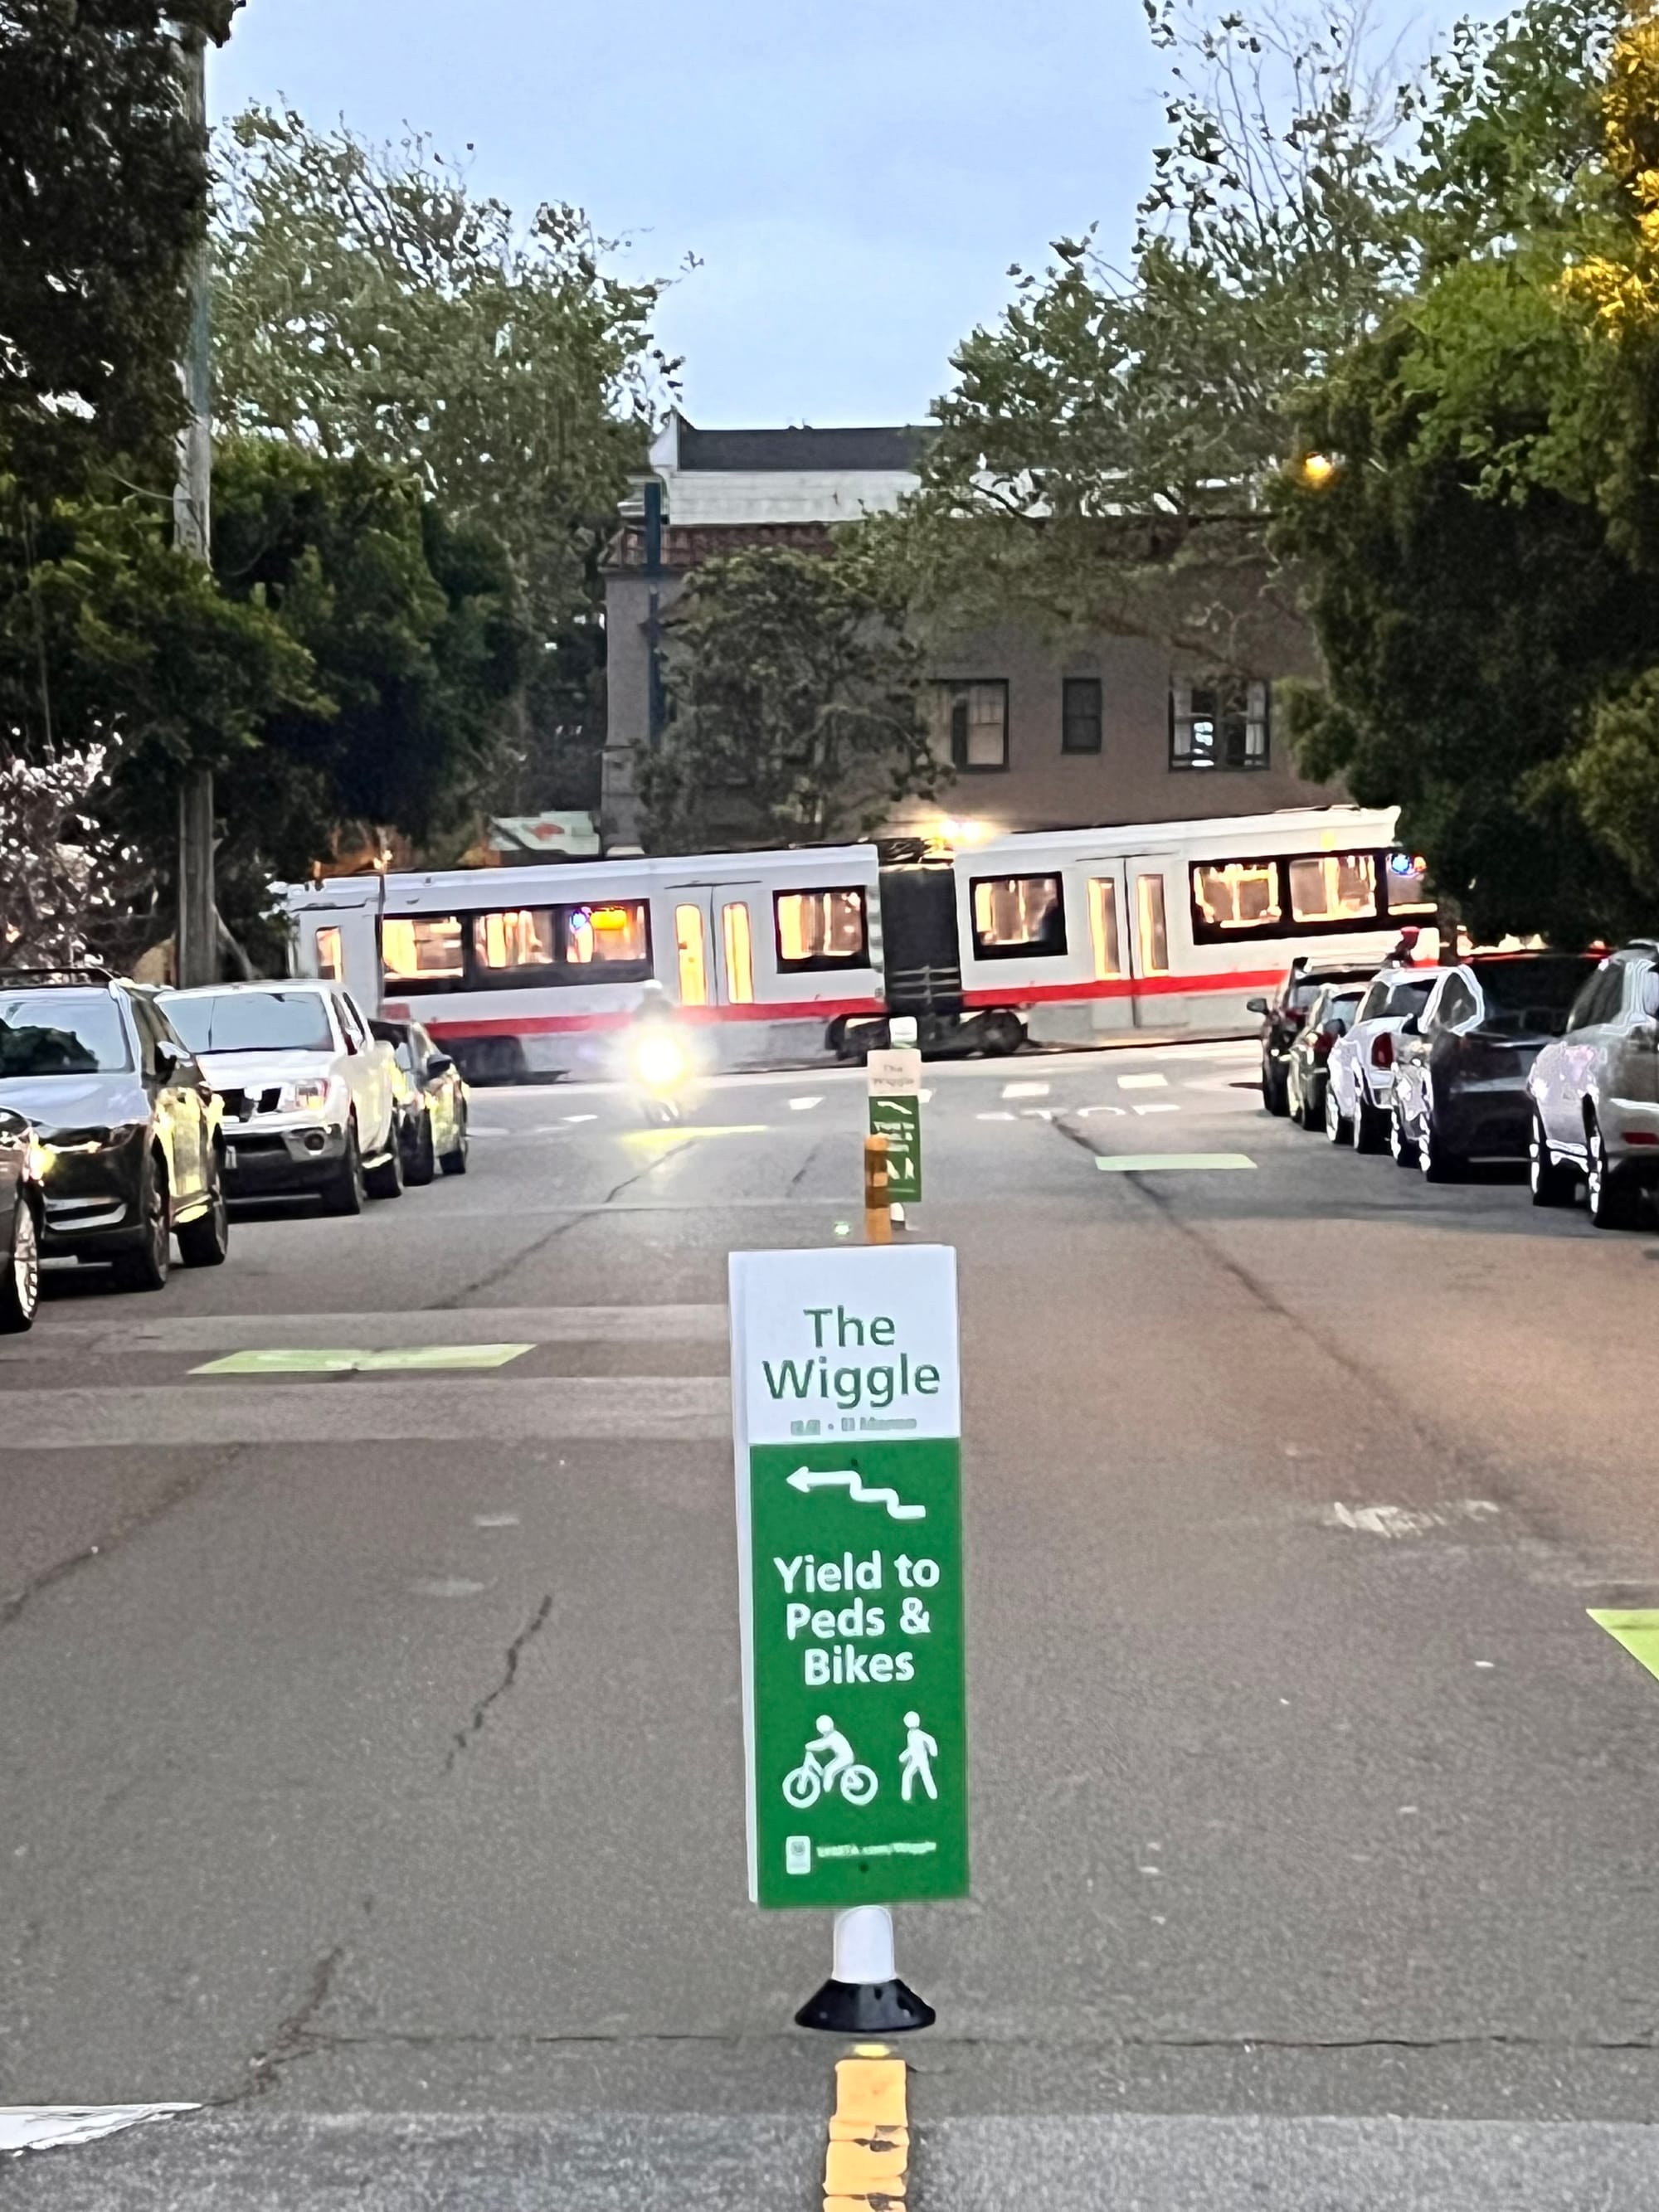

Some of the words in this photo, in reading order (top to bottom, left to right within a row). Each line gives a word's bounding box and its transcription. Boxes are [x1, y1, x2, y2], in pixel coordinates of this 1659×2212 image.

[803, 1305, 895, 1348] The
[761, 1353, 940, 1408] Wiggle
[773, 1550, 882, 1593] Yield
[893, 1553, 940, 1587] to
[787, 1597, 885, 1641] Peds
[900, 1597, 931, 1635] &
[805, 1644, 915, 1685] Bikes
